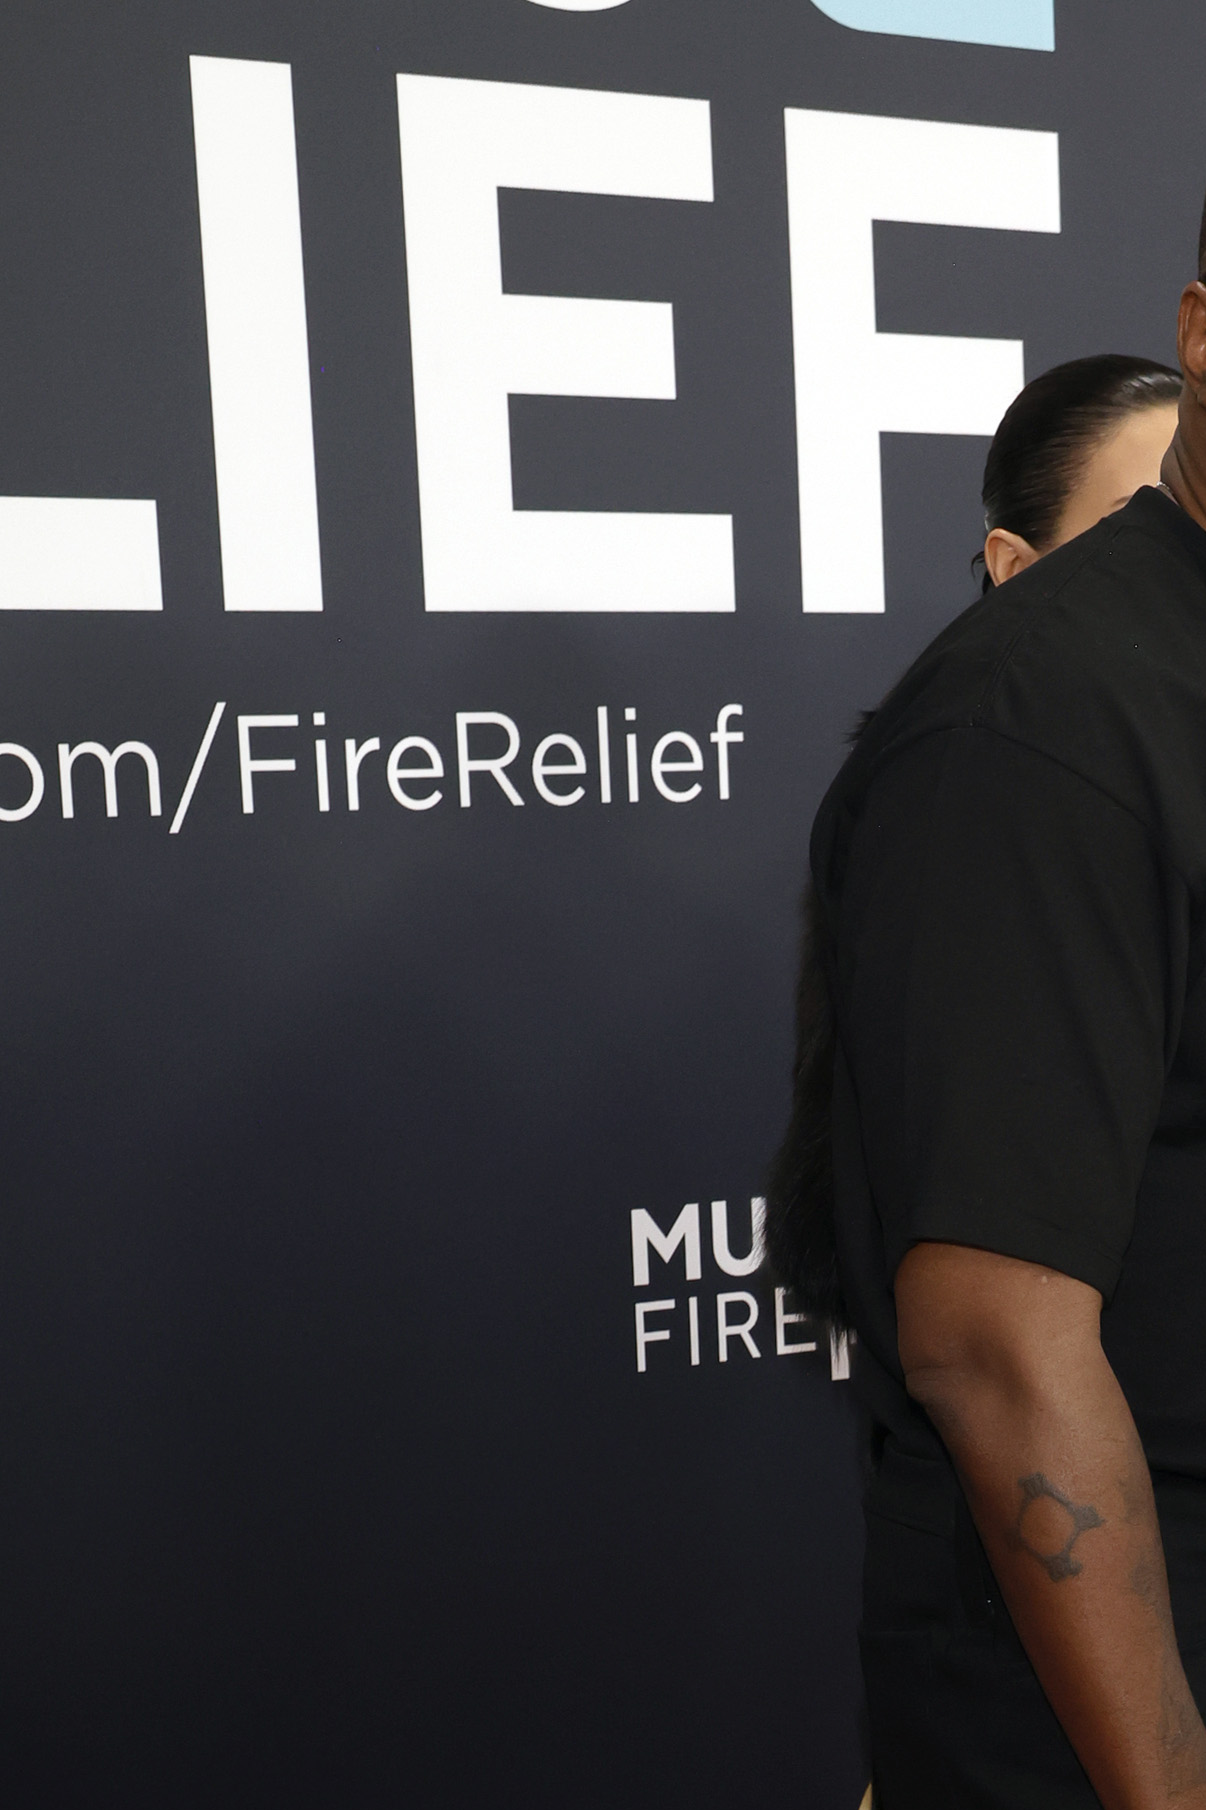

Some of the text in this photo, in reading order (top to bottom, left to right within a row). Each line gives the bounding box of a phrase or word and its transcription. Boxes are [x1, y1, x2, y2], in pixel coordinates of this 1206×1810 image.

[0, 54, 1061, 614] IEF
[0, 702, 745, 834] om/FireRelief
[634, 1287, 817, 1373] FIRE
